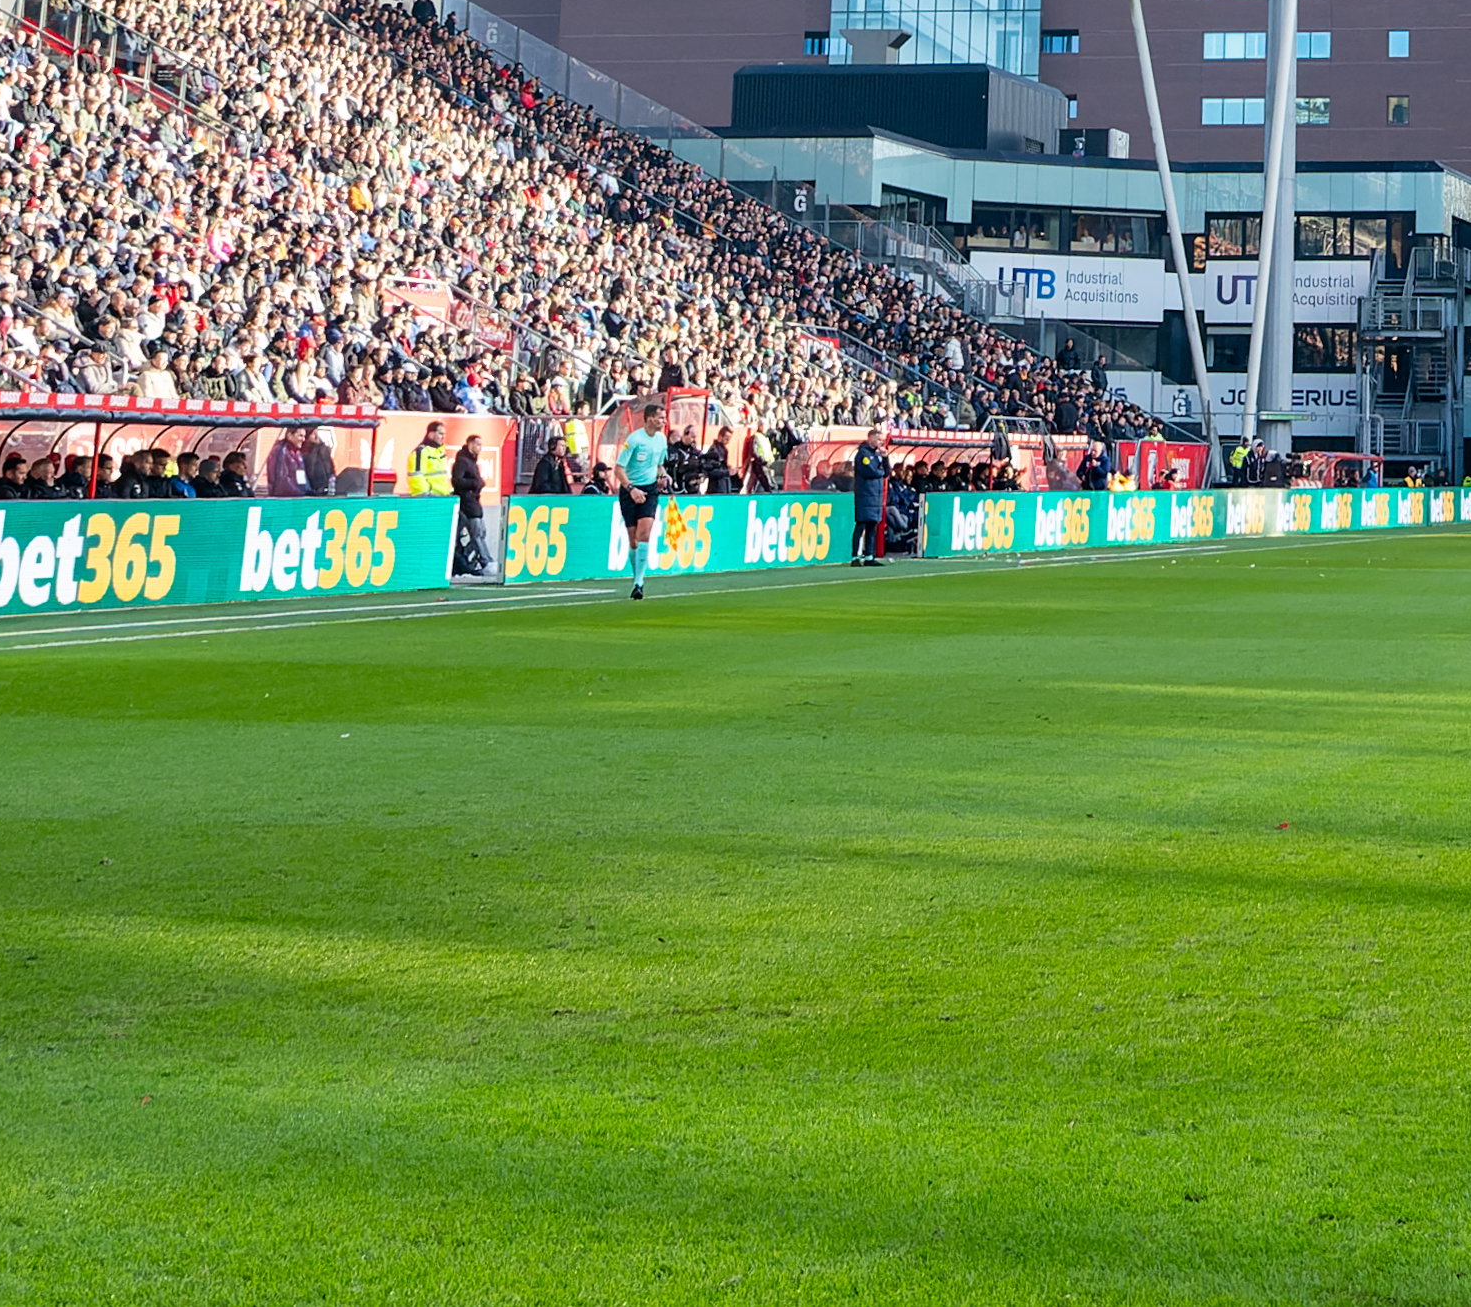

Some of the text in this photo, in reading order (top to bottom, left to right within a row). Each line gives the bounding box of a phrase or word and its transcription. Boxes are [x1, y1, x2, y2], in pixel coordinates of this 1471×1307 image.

[998, 267, 1056, 299] UTB
[1064, 288, 1139, 306] Acquisitions
[1066, 270, 1123, 286] Industrial
[1217, 275, 1258, 305] UT
[1294, 274, 1355, 289] ndustrial
[1292, 291, 1361, 308] Acquisitio
[1221, 389, 1358, 407] JOERIUS
[951, 496, 1016, 551] bet365
[1034, 495, 1091, 546] bet365
[1106, 494, 1156, 542] bet365
[1170, 493, 1215, 538] bet365
[1226, 491, 1266, 535] bet365
[1278, 491, 1312, 533] bet365
[1321, 490, 1353, 530] bet365
[1361, 490, 1390, 527] bet365
[1397, 489, 1425, 525] bet365
[1430, 489, 1455, 523] bet365
[240, 505, 399, 592] bet365
[505, 505, 569, 577] 365
[744, 500, 832, 564] bet365
